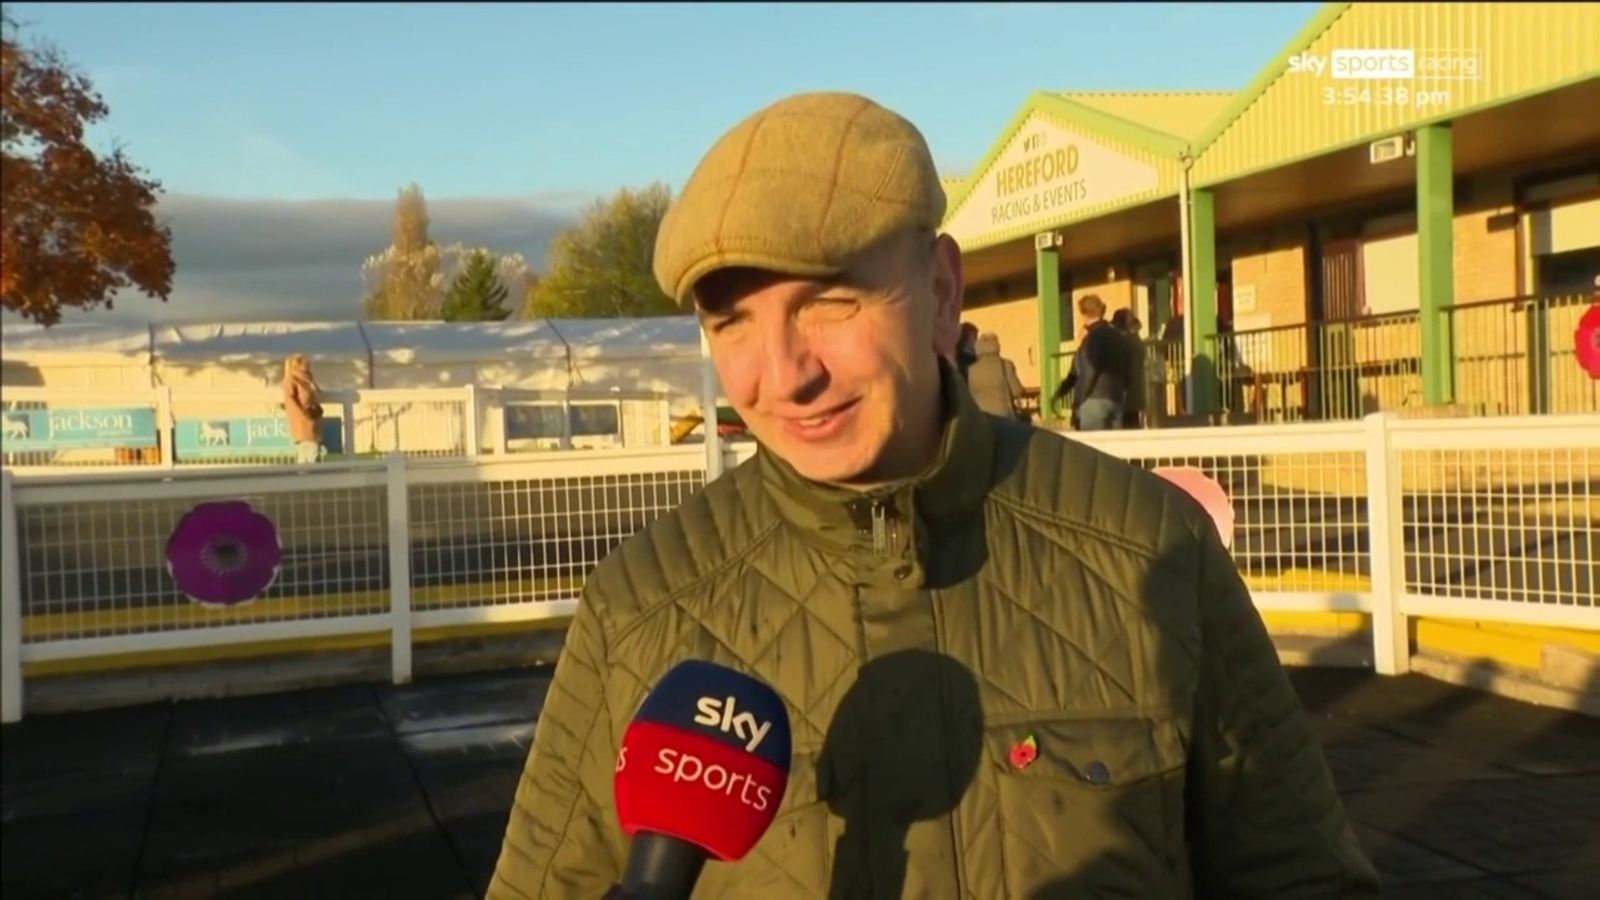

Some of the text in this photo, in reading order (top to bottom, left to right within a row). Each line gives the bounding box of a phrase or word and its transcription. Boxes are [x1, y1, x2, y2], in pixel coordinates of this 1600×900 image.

[996, 144, 1079, 198] HEREFORD
[991, 178, 1087, 225] RACING & EVENTS
[48, 410, 133, 439] jackson
[245, 418, 287, 447] jack
[694, 696, 772, 752] sky
[654, 747, 772, 811] sports
